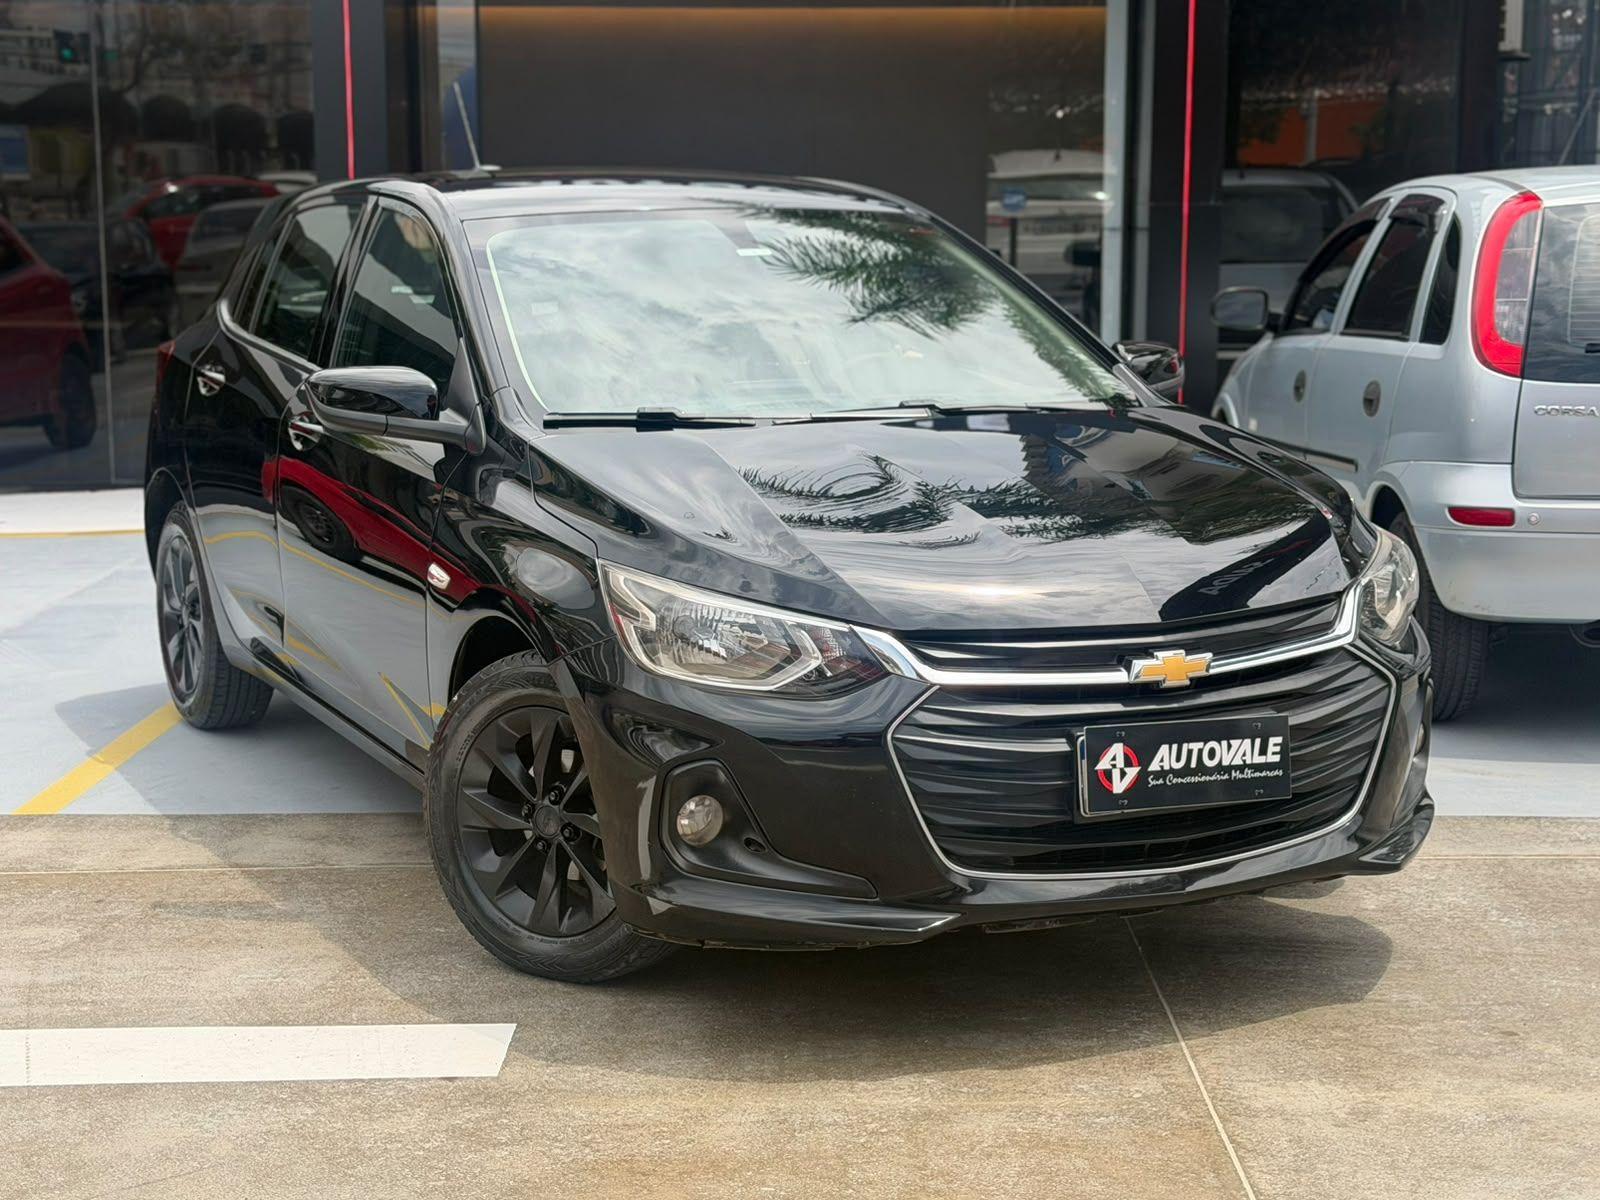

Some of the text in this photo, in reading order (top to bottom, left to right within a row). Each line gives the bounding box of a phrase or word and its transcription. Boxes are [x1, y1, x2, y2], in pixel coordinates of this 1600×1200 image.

[1534, 405, 1600, 417] CORSA
[1147, 736, 1283, 772] AUTOVALE
[1147, 774, 1164, 787] Sua
[1231, 767, 1283, 780] Multimarcas
